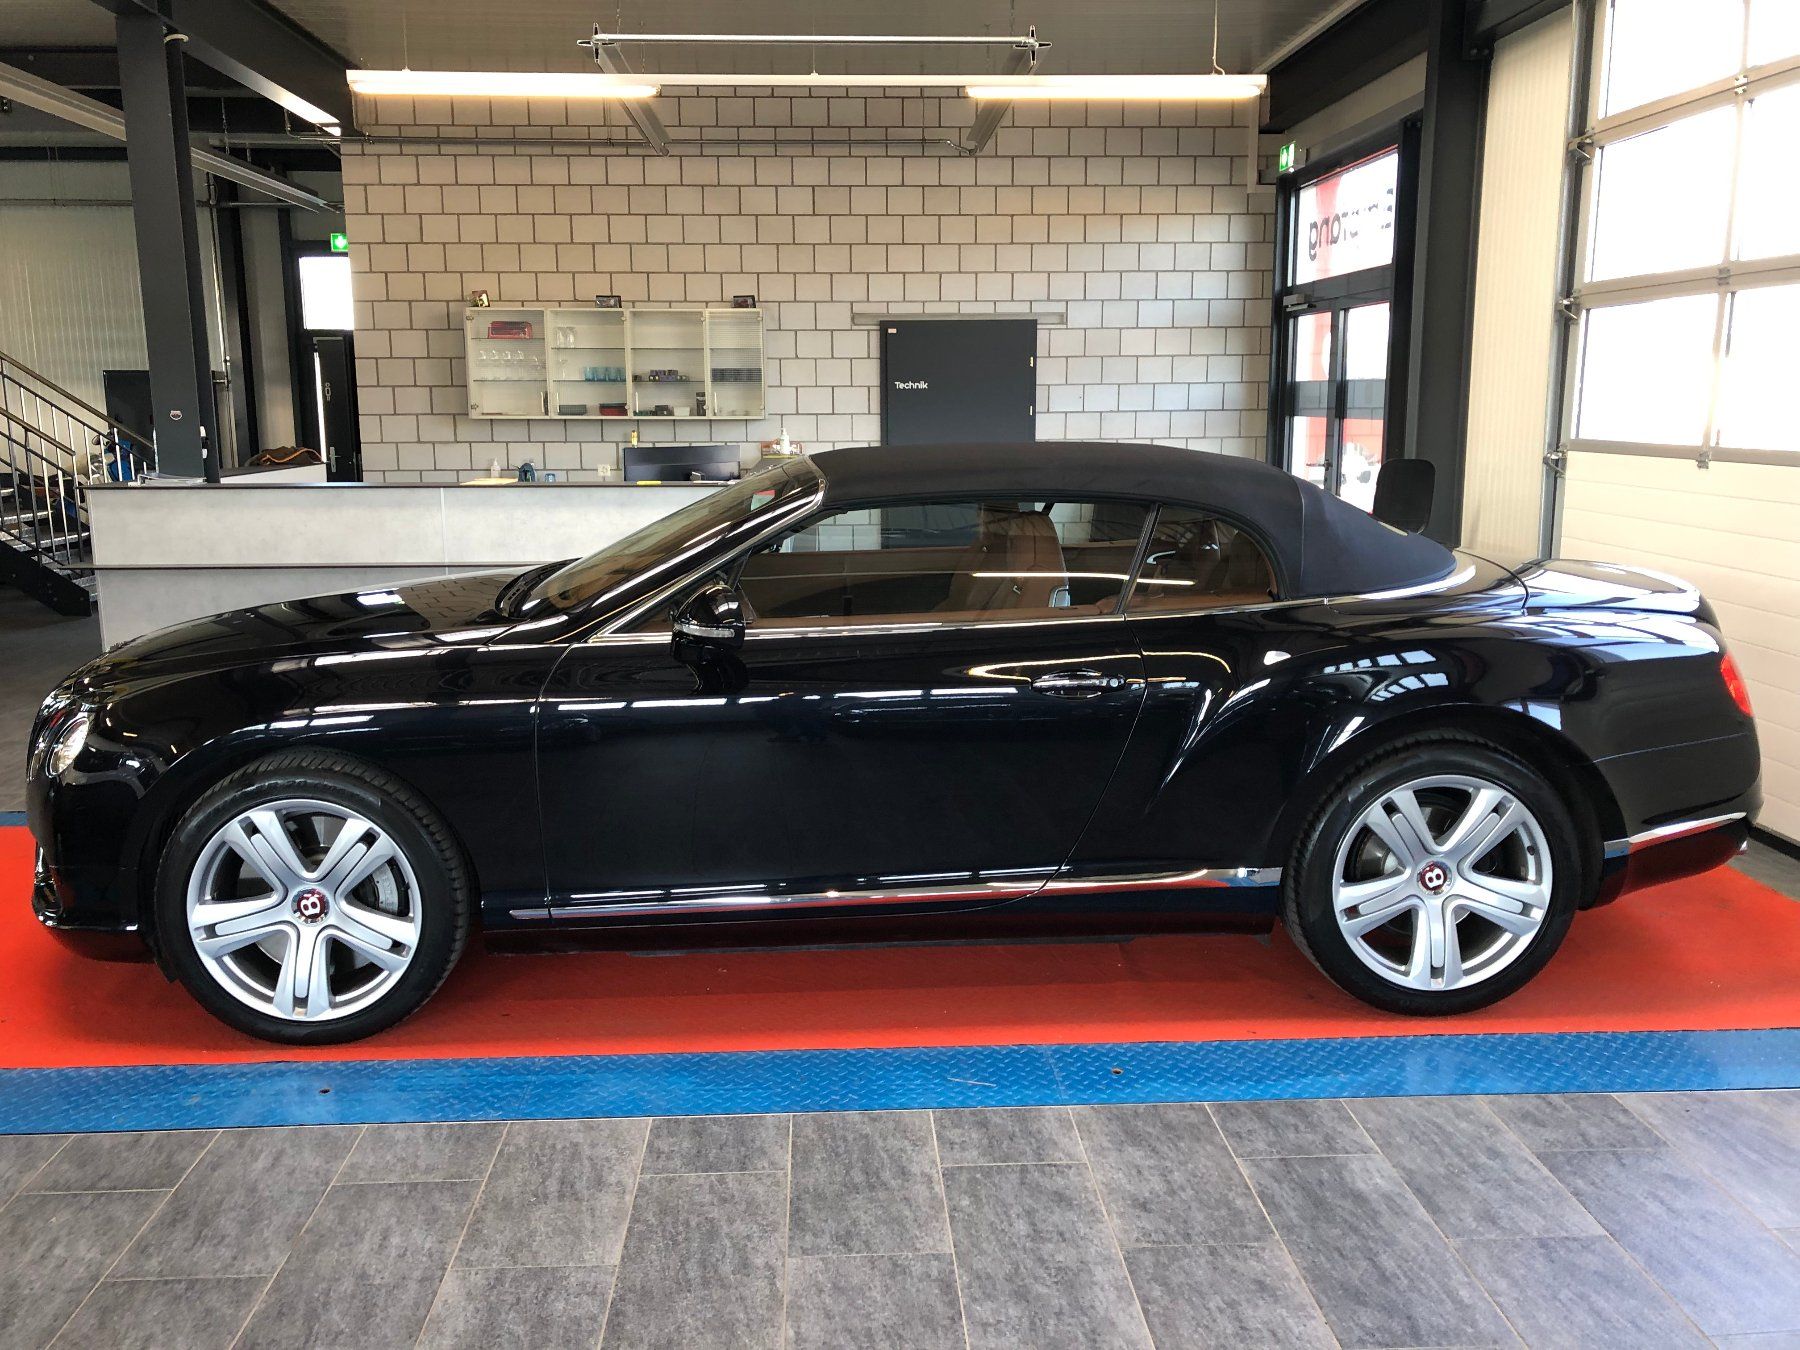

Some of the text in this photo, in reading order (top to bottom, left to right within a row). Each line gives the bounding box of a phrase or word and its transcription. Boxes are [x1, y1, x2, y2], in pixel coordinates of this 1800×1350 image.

[894, 381, 928, 389] Technik
[1425, 868, 1444, 888] B
[300, 896, 320, 916] B
